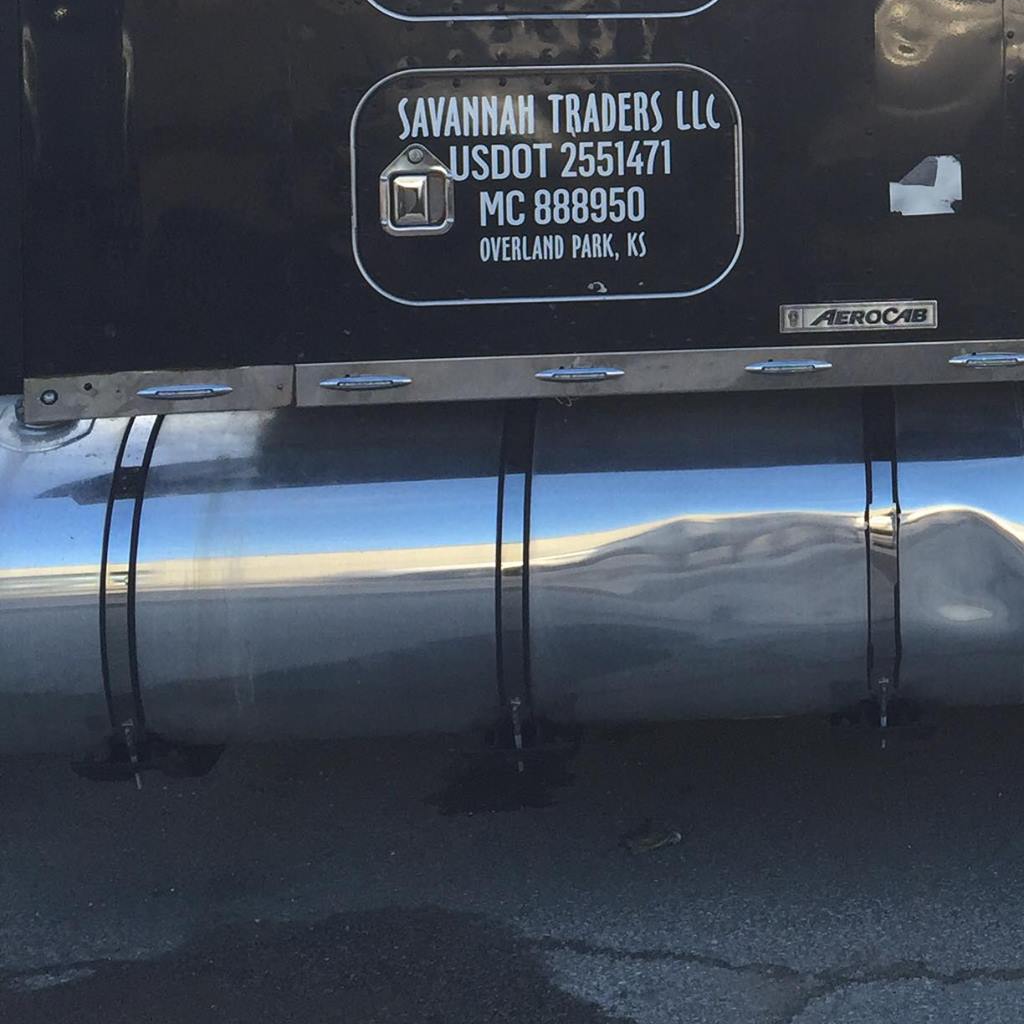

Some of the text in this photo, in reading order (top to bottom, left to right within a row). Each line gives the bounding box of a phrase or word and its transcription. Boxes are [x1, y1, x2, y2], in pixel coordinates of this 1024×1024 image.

[398, 90, 721, 140] SAVANNAH TRADERS LLC
[449, 138, 671, 182] USDOT 2551471
[479, 186, 645, 227] MC 888950
[480, 231, 647, 263] OVERLAND PARK, KS
[810, 307, 928, 326] AEROCAB
